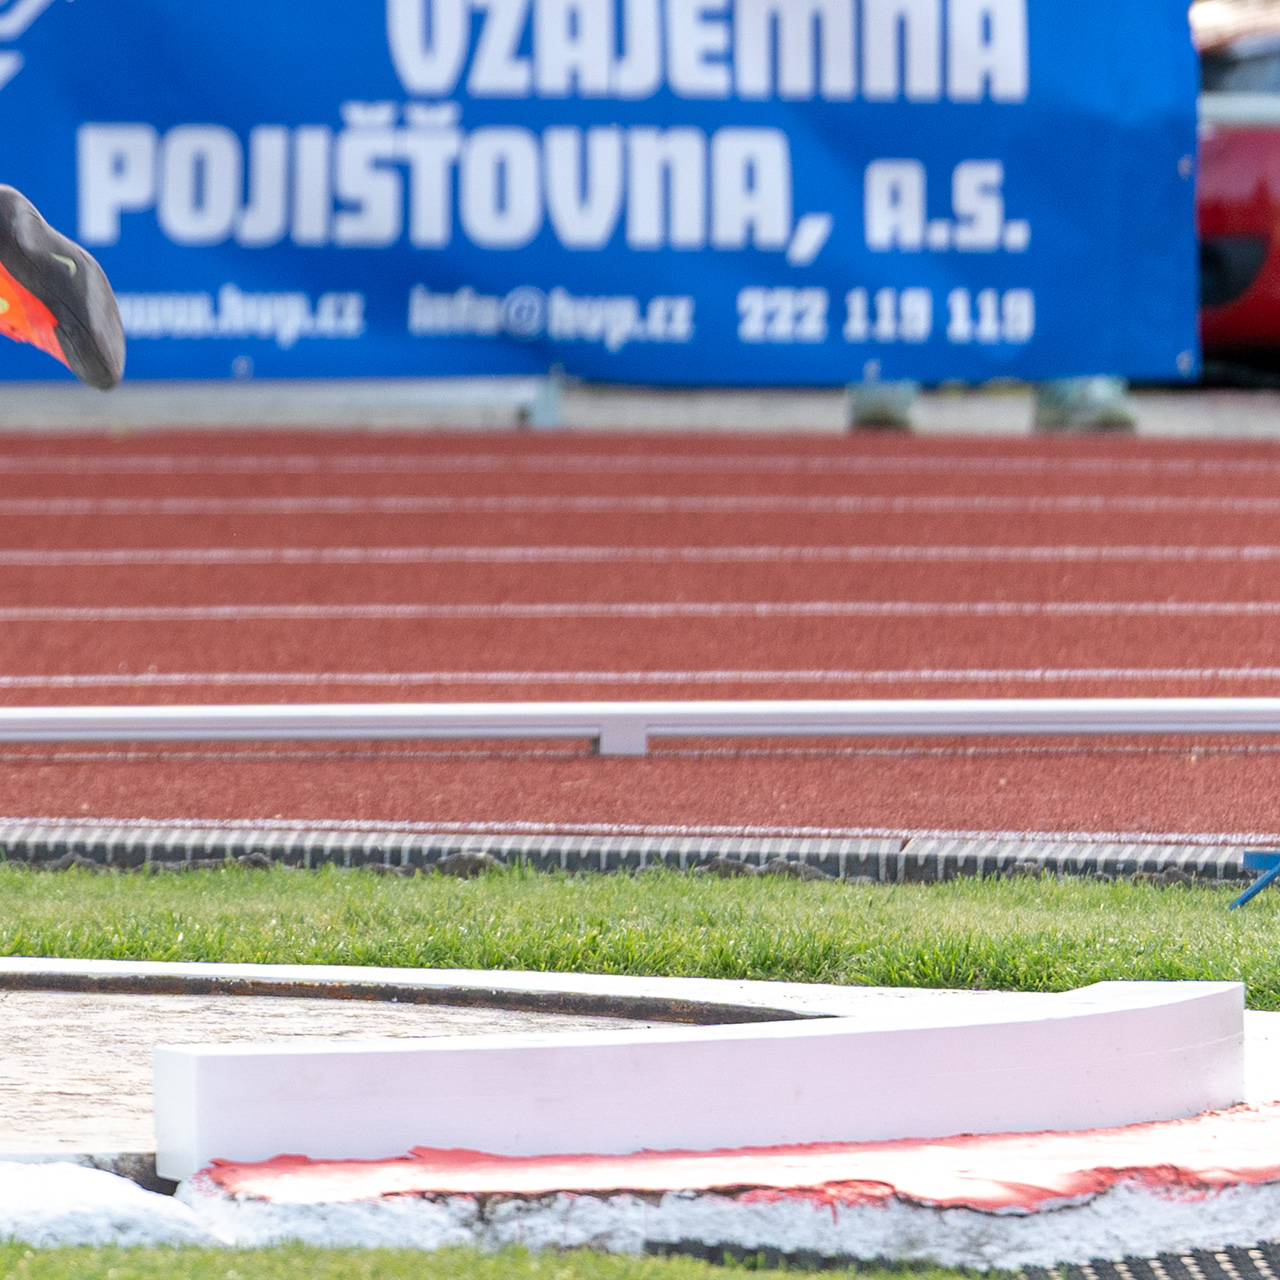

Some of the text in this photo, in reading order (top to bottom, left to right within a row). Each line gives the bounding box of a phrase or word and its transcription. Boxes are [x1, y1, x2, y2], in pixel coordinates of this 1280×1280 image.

[76, 102, 833, 266] POJIŠŤOVNA,
[115, 282, 366, 349] ww.hvp.cz
[736, 285, 829, 344] 222
